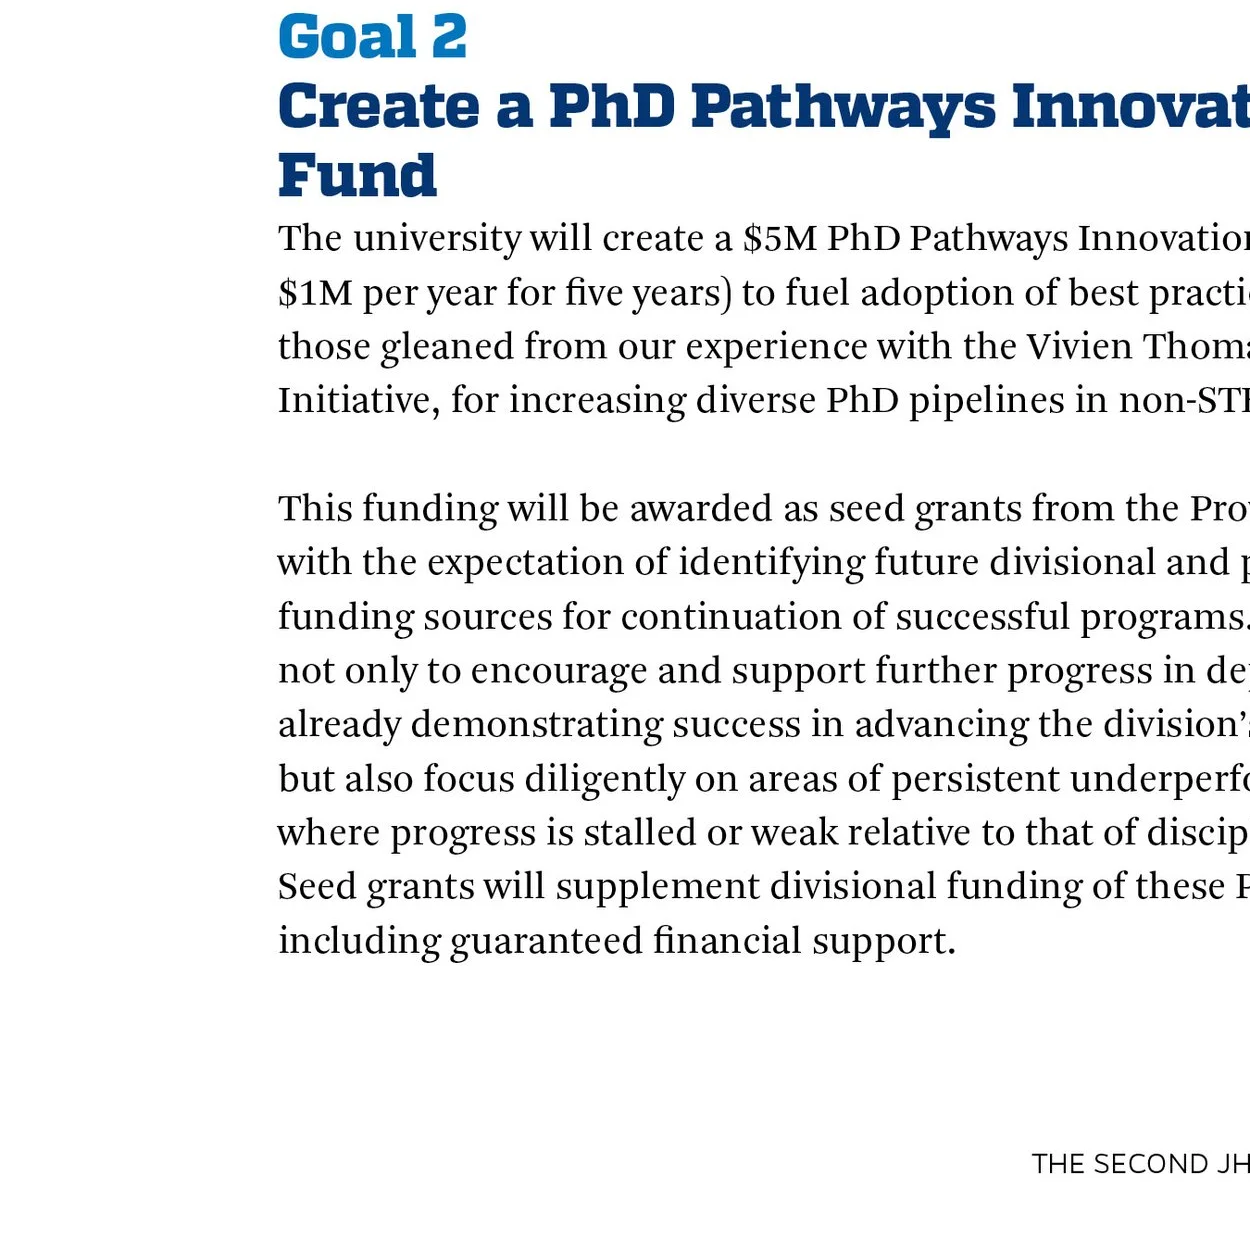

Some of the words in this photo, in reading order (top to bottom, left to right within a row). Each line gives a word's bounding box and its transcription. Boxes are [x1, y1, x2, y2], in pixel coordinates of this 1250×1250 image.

[279, 12, 417, 59] Goal
[432, 12, 467, 59] 2
[278, 81, 480, 129] Create
[496, 91, 534, 129] a
[549, 82, 675, 128] PhD
[691, 82, 997, 139] Pathways
[278, 152, 438, 198] Fund
[277, 221, 342, 252] The
[353, 221, 523, 261] university
[529, 221, 593, 252] will
[602, 225, 704, 252] create
[715, 230, 734, 252] a
[743, 222, 818, 255] $5M
[827, 221, 901, 251] PhD
[909, 221, 1069, 261] Pathways
[278, 276, 353, 310] $1M
[362, 285, 420, 315] per
[425, 285, 498, 316] year
[506, 276, 557, 307] for
[565, 276, 623, 307] five
[631, 275, 732, 316] years)
[741, 279, 775, 307] to
[785, 276, 850, 307] fuel
[861, 276, 1015, 315] adoption
[1024, 276, 1062, 307] of
[1068, 276, 1140, 307] best
[278, 330, 371, 360] those
[380, 330, 515, 370] gleaned
[524, 329, 608, 361] from
[618, 339, 677, 360] our
[686, 329, 868, 369] experience
[876, 329, 953, 360] with
[963, 330, 1017, 360] the
[1025, 329, 1134, 360] Vivien
[278, 383, 440, 421] Initiative,
[451, 383, 500, 414] for
[509, 383, 688, 423] increasing
[696, 383, 816, 414] diverse
[826, 384, 899, 413] PhD
[909, 383, 1065, 423] pipelines
[1075, 383, 1109, 413] in
[277, 491, 353, 523] This
[362, 491, 500, 532] funding
[506, 491, 570, 522] will
[579, 492, 619, 523] be
[630, 492, 773, 523] awarded
[784, 501, 819, 523] as
[829, 492, 906, 523] seed
[914, 495, 1022, 532] grants
[1031, 491, 1116, 523] from
[1125, 492, 1179, 523] the
[276, 545, 353, 576] with
[362, 545, 417, 576] the
[427, 545, 625, 585] expectation
[635, 545, 672, 576] of
[679, 545, 867, 585] identifying
[874, 545, 979, 576] future
[990, 545, 1157, 576] divisional
[1166, 546, 1231, 576] and
[278, 600, 416, 640] funding
[424, 609, 553, 631] sources
[562, 600, 612, 631] for
[621, 600, 843, 631] continuation
[852, 600, 889, 631] of
[896, 600, 1071, 631] successful
[278, 657, 336, 685] not
[345, 654, 420, 694] only
[427, 657, 462, 685] to
[471, 663, 647, 694] encourage
[658, 654, 722, 685] and
[732, 657, 867, 693] support
[875, 653, 998, 685] further
[1007, 663, 1153, 694] progress
[1163, 653, 1196, 684] in
[278, 708, 403, 747] already
[411, 707, 665, 747] demonstrating
[673, 716, 801, 738] success
[811, 707, 845, 737] in
[855, 707, 1031, 747] advancing
[1038, 708, 1093, 738] the
[278, 762, 336, 793] but
[345, 762, 413, 793] also
[423, 762, 515, 793] focus
[525, 762, 687, 802] diligently
[695, 771, 739, 793] on
[749, 771, 838, 793] areas
[848, 762, 885, 793] of
[891, 762, 1061, 801] persistent
[276, 816, 380, 847] where
[390, 825, 536, 856] progress
[546, 815, 574, 847] is
[584, 816, 697, 847] stalled
[707, 825, 744, 847] or
[750, 815, 840, 847] weak
[847, 815, 971, 847] relative
[981, 819, 1015, 847] to
[1025, 816, 1095, 847] that
[1103, 816, 1140, 847] of
[278, 870, 358, 900] Seed
[366, 873, 475, 910] grants
[482, 869, 546, 900] will
[556, 869, 761, 909] supplement
[770, 869, 937, 900] divisional
[946, 869, 1085, 910] funding
[1092, 869, 1129, 900] of
[1135, 870, 1225, 900] these
[278, 924, 443, 964] including
[449, 924, 644, 964] guaranteed
[653, 924, 802, 955] financial
[813, 928, 956, 963] support.
[1031, 1152, 1085, 1174] THE
[1094, 1152, 1209, 1174] SECOND
